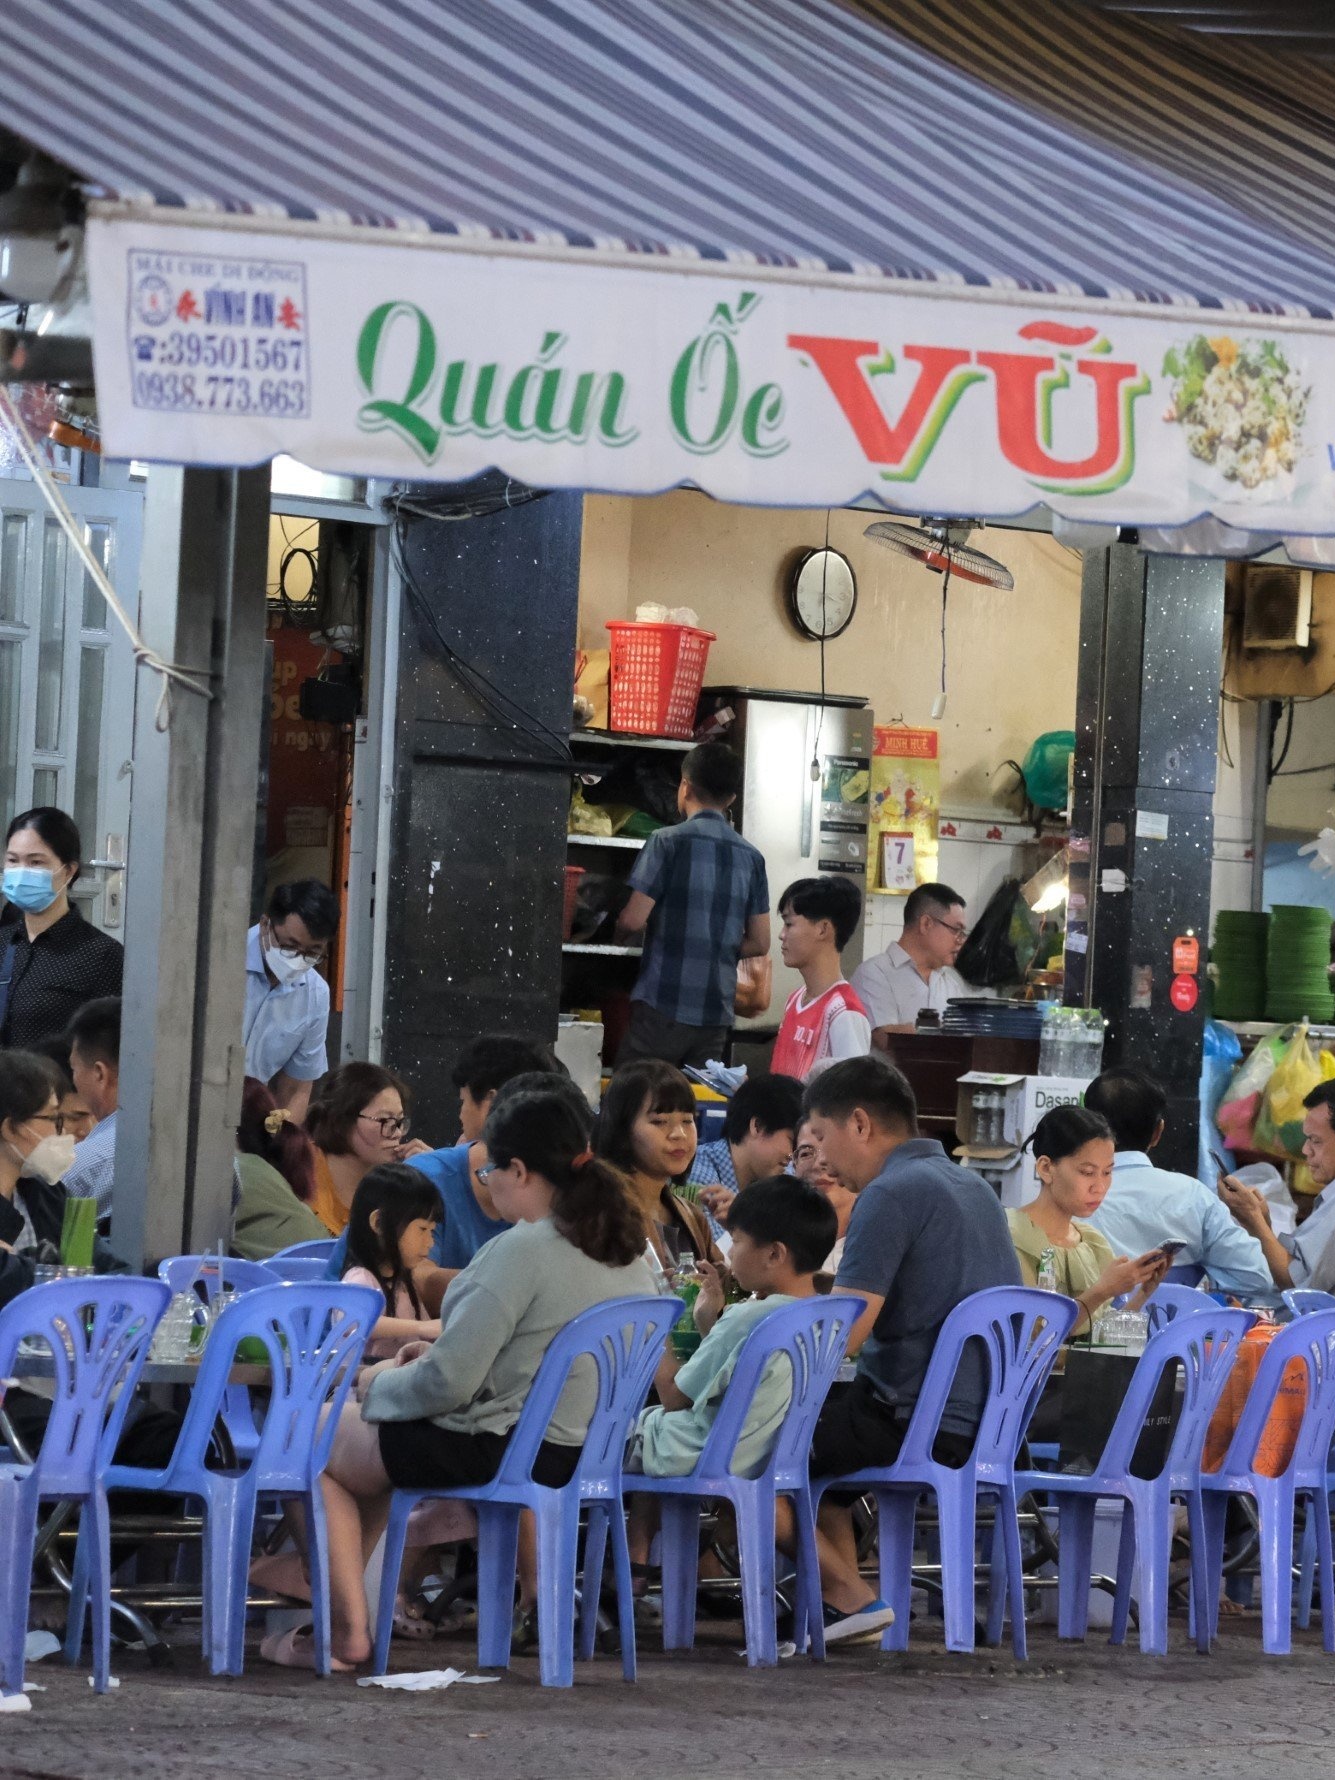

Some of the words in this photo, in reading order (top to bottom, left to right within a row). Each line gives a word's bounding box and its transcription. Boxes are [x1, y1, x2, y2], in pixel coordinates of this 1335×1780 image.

[356, 299, 640, 467] Quán
[669, 291, 791, 457] Ốc
[786, 319, 1151, 497] VŨ
[894, 842, 905, 864] 7
